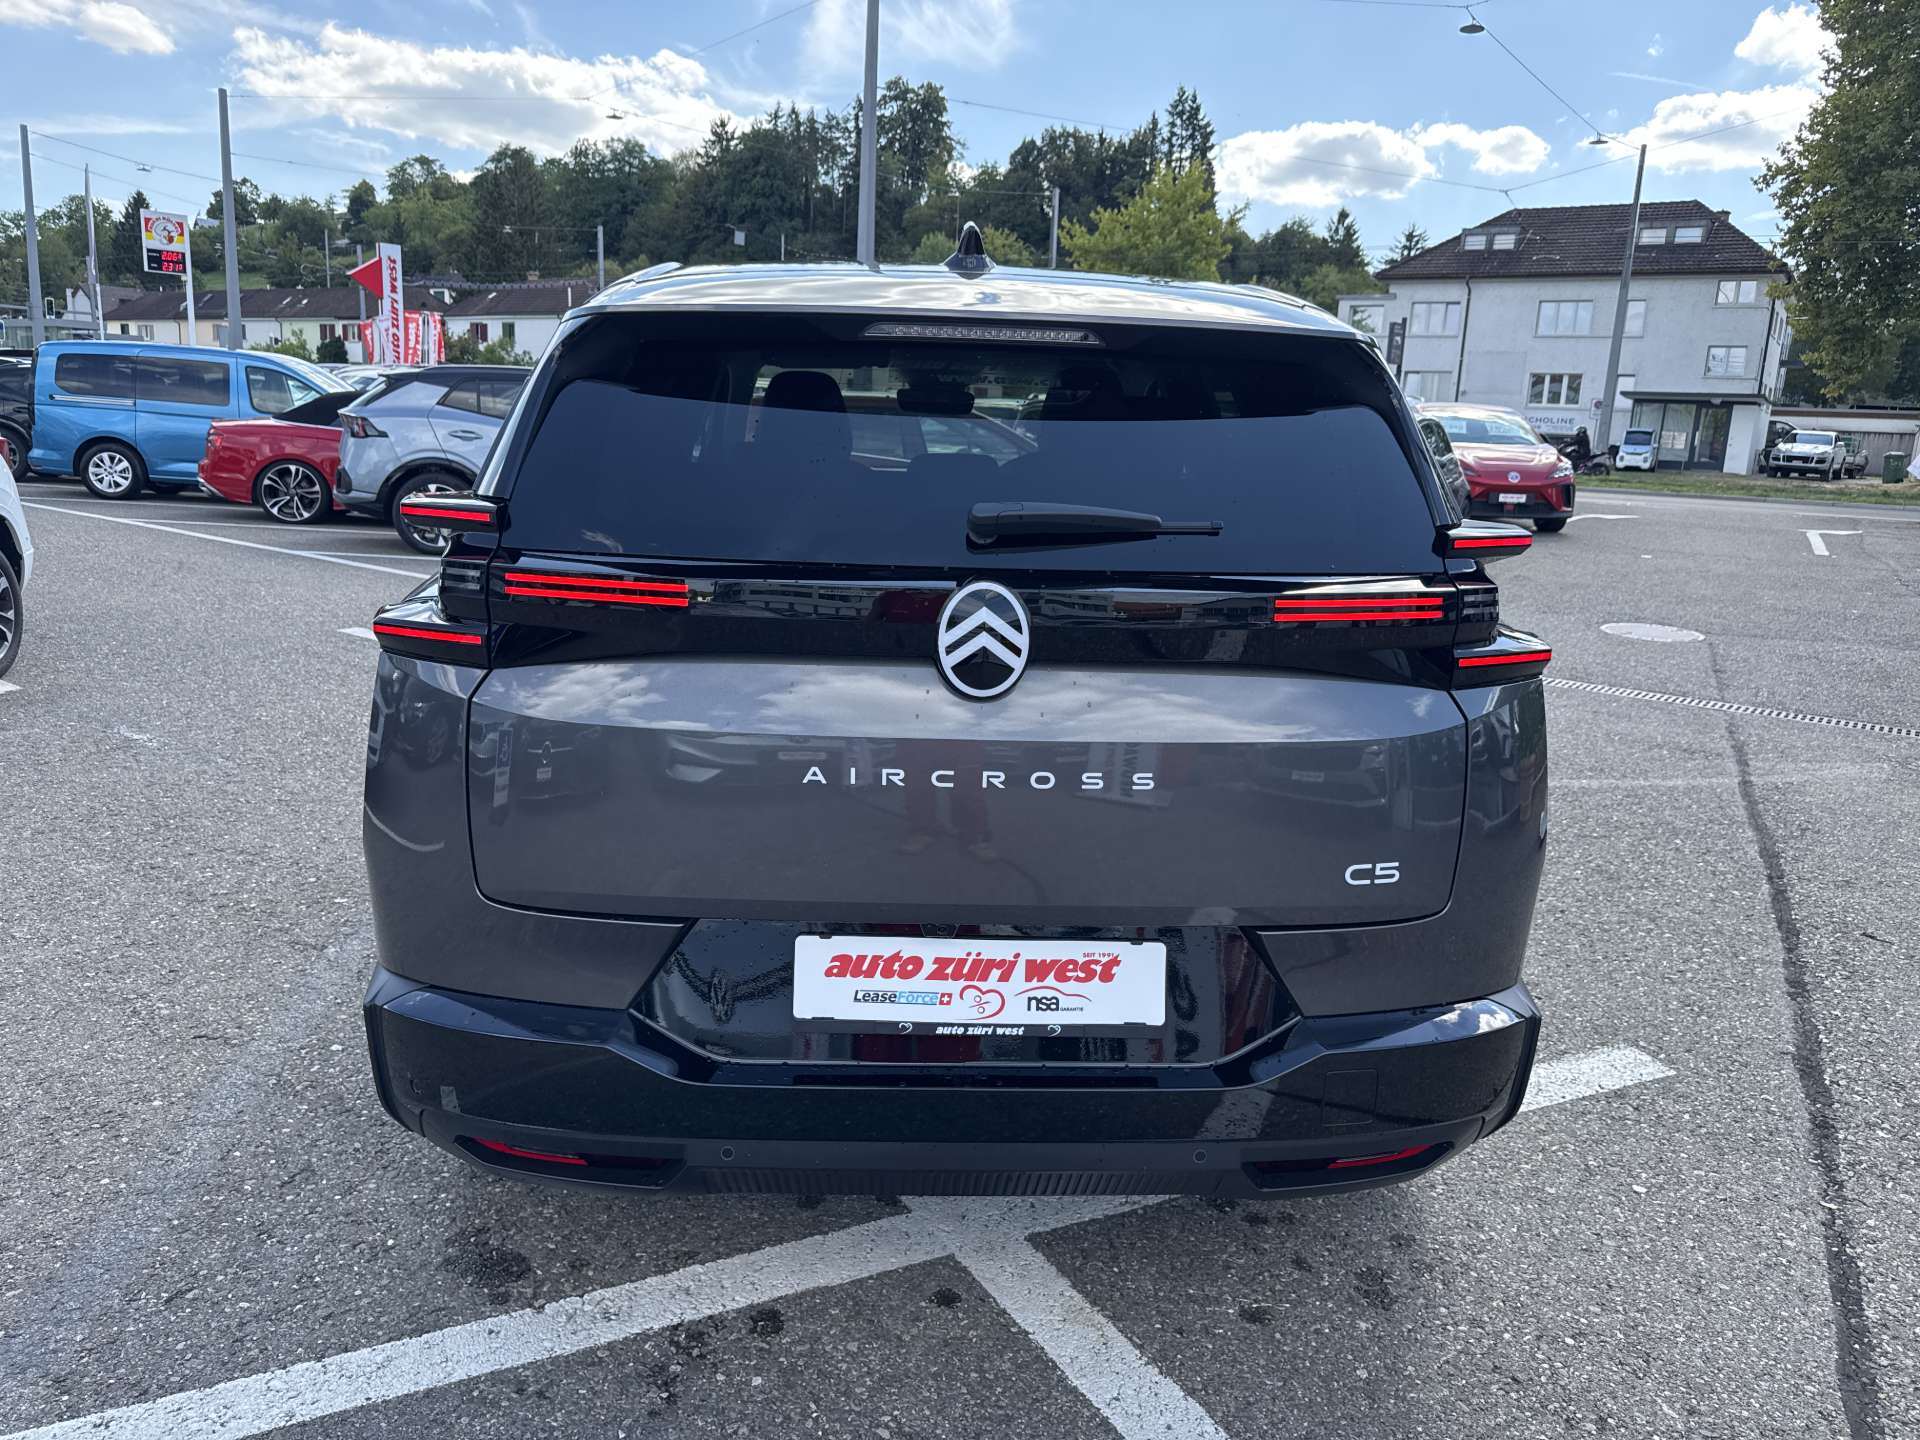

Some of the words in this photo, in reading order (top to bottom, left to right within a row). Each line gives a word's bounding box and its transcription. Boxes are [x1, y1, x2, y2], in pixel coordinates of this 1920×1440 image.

[1525, 416, 1576, 425] CHOLINE
[802, 766, 1155, 790] AIRCROSS
[1344, 862, 1400, 886] C5
[824, 949, 924, 980] auto
[924, 951, 1021, 983] züri
[1024, 953, 1122, 984] west
[853, 989, 939, 1004] LeaseForce
[1027, 996, 1060, 1012] nsa
[935, 1025, 965, 1035] auto
[966, 1025, 994, 1035] züri
[995, 1026, 1025, 1036] west
